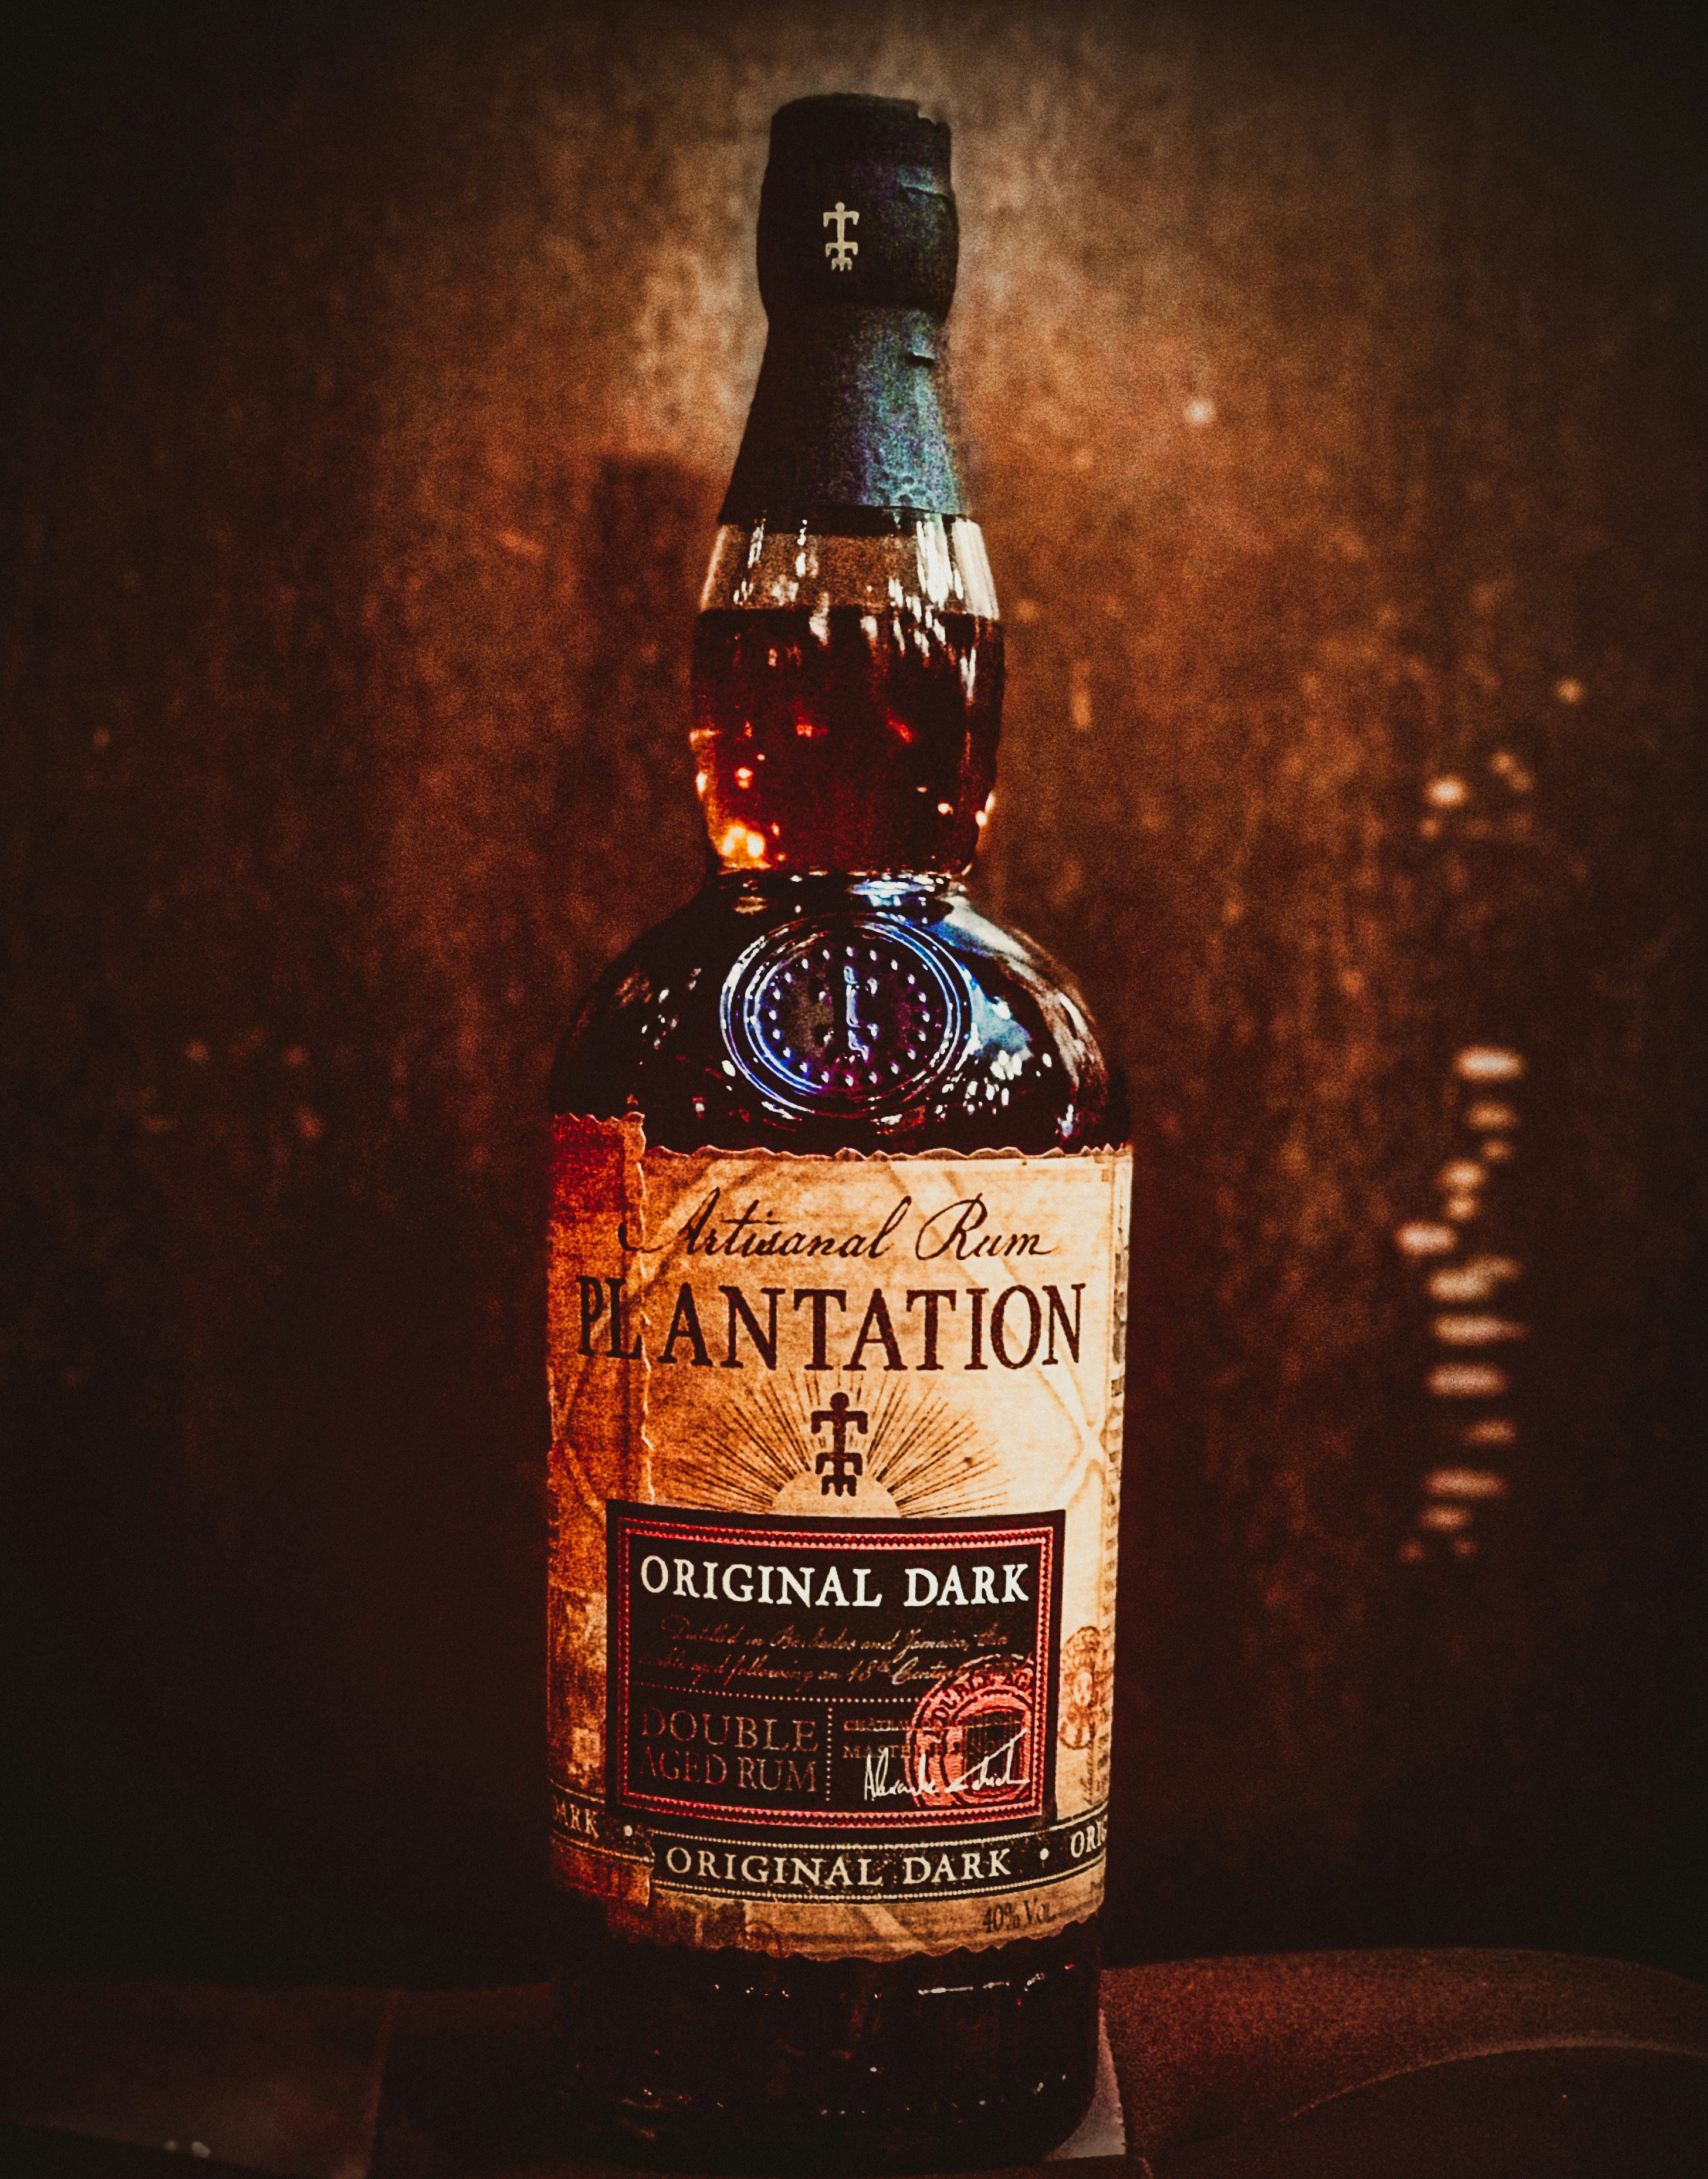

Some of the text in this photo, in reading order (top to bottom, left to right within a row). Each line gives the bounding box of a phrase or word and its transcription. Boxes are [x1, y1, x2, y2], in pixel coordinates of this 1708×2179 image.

[617, 1186, 1057, 1261] Artisanal Rum
[576, 1275, 1086, 1371] PLANTATION
[640, 1554, 1031, 1608] ORIGINAL DARK
[641, 1706, 819, 1752] DOUBLE
[640, 1745, 816, 1792] AGED RUM
[666, 1847, 884, 1887] ORIGINAL
[902, 1848, 1012, 1886] DARK
